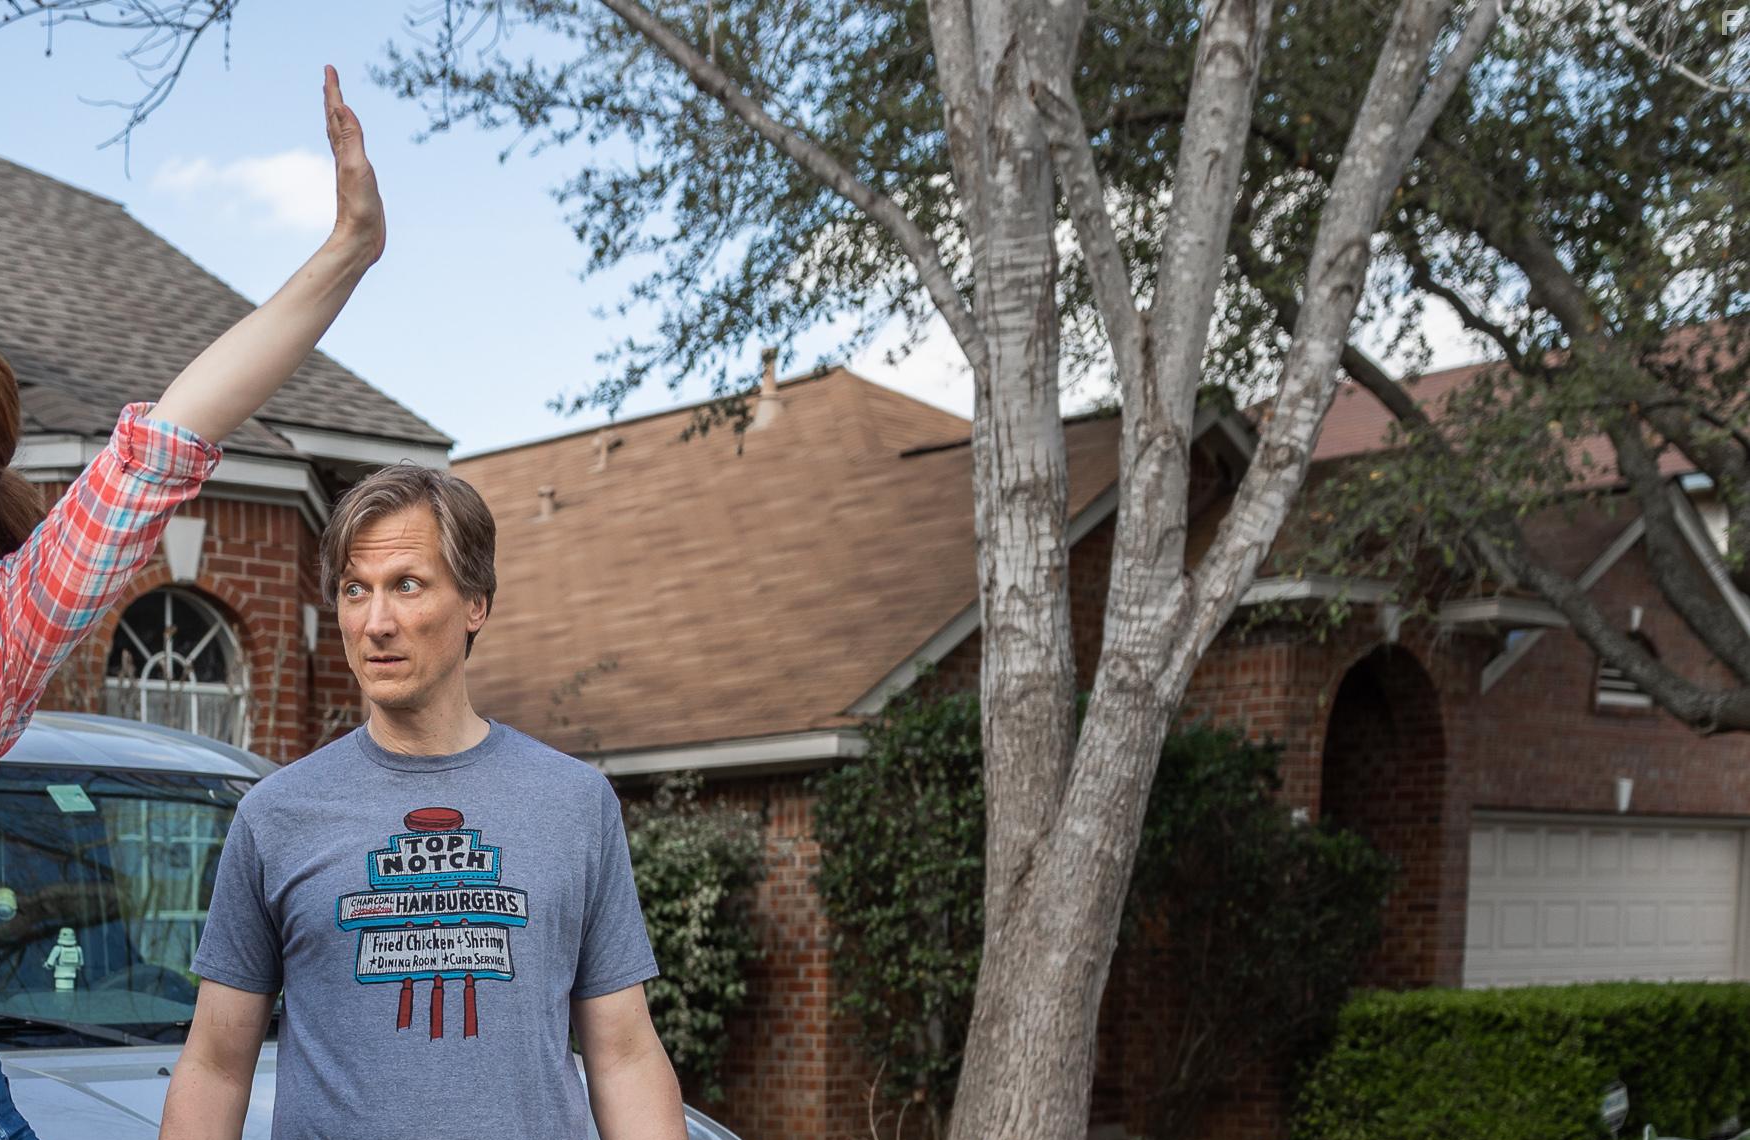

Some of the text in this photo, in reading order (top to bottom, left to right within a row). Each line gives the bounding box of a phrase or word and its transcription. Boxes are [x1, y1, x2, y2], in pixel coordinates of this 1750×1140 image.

[405, 836, 464, 854] TOP
[382, 851, 485, 874] NOTCH
[351, 897, 394, 907] CHARCOAL
[396, 892, 519, 913] HAMBURGERS
[372, 935, 403, 953] Fried
[406, 932, 454, 951] Chicken
[464, 930, 504, 954] Shrimp
[377, 956, 410, 969] DINING
[450, 953, 472, 965] CURB
[474, 952, 505, 966] SERVICE
